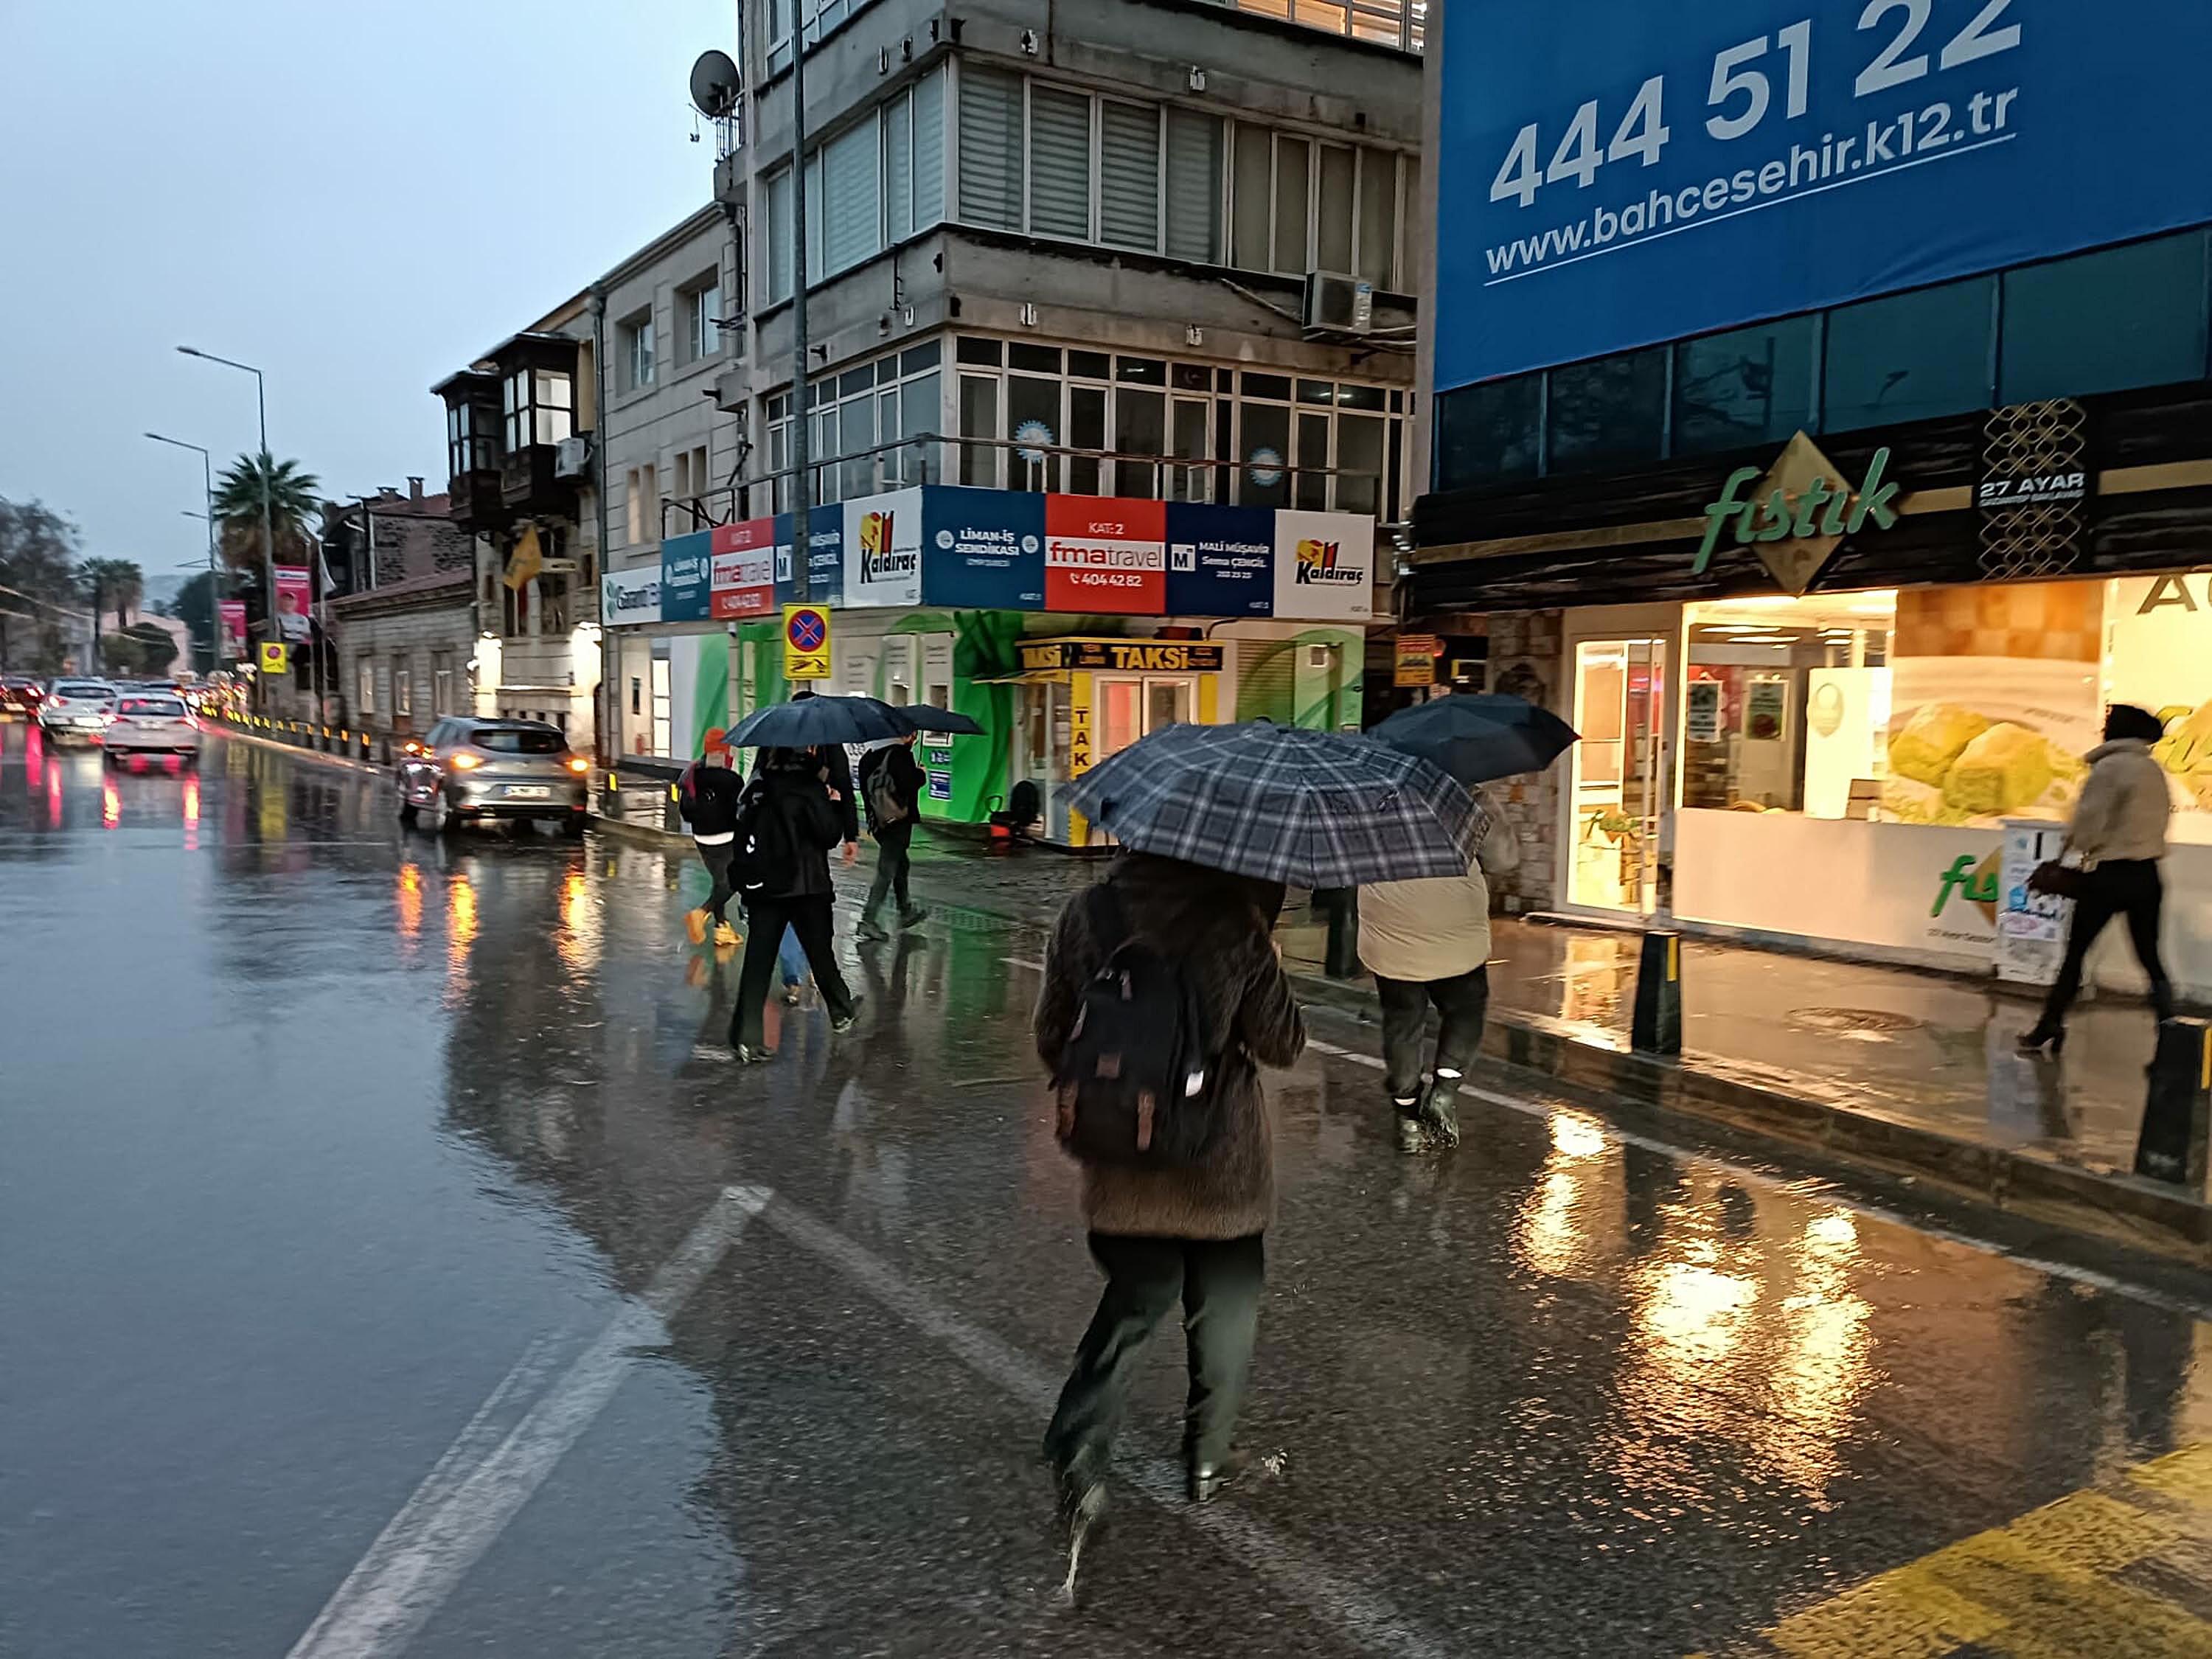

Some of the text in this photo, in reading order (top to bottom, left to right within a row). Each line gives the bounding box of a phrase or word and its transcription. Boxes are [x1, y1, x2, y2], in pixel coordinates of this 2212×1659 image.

[1489, 0, 2021, 208] 444 51 22
[1486, 86, 2019, 274] www.bahcesehir.k12.tr
[1980, 472, 2086, 498] 27 AYAR
[1050, 541, 1162, 567] fmatravel
